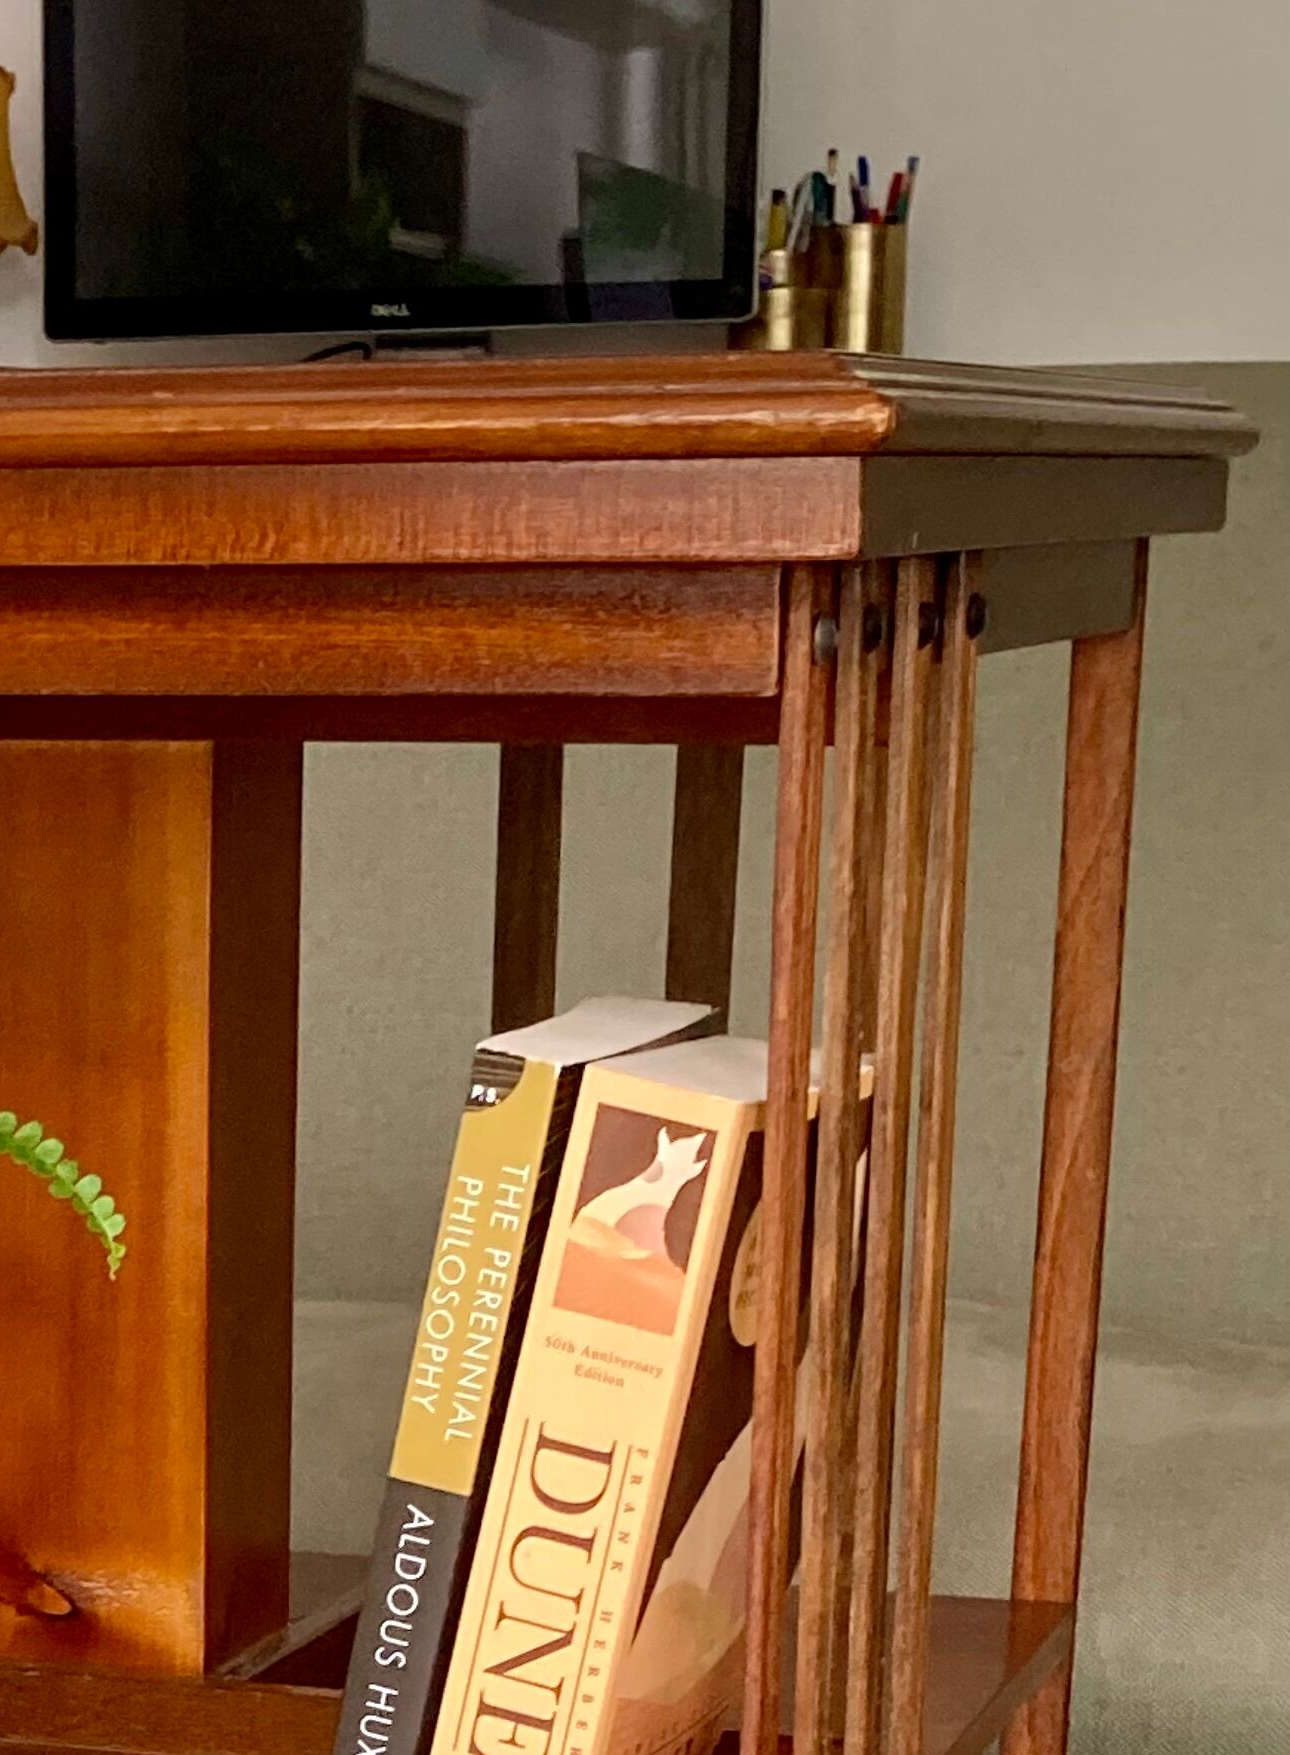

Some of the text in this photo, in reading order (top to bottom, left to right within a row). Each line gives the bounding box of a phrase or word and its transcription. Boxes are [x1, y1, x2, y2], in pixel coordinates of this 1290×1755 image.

[411, 1174, 485, 1415] PHILOSOPHY
[444, 1163, 531, 1442] THE PERENNIAL
[545, 1335, 665, 1379] 50th Anniversary
[574, 1364, 626, 1388] Edition
[611, 1447, 649, 1573] FRANK
[374, 1503, 435, 1670] ALDOUS
